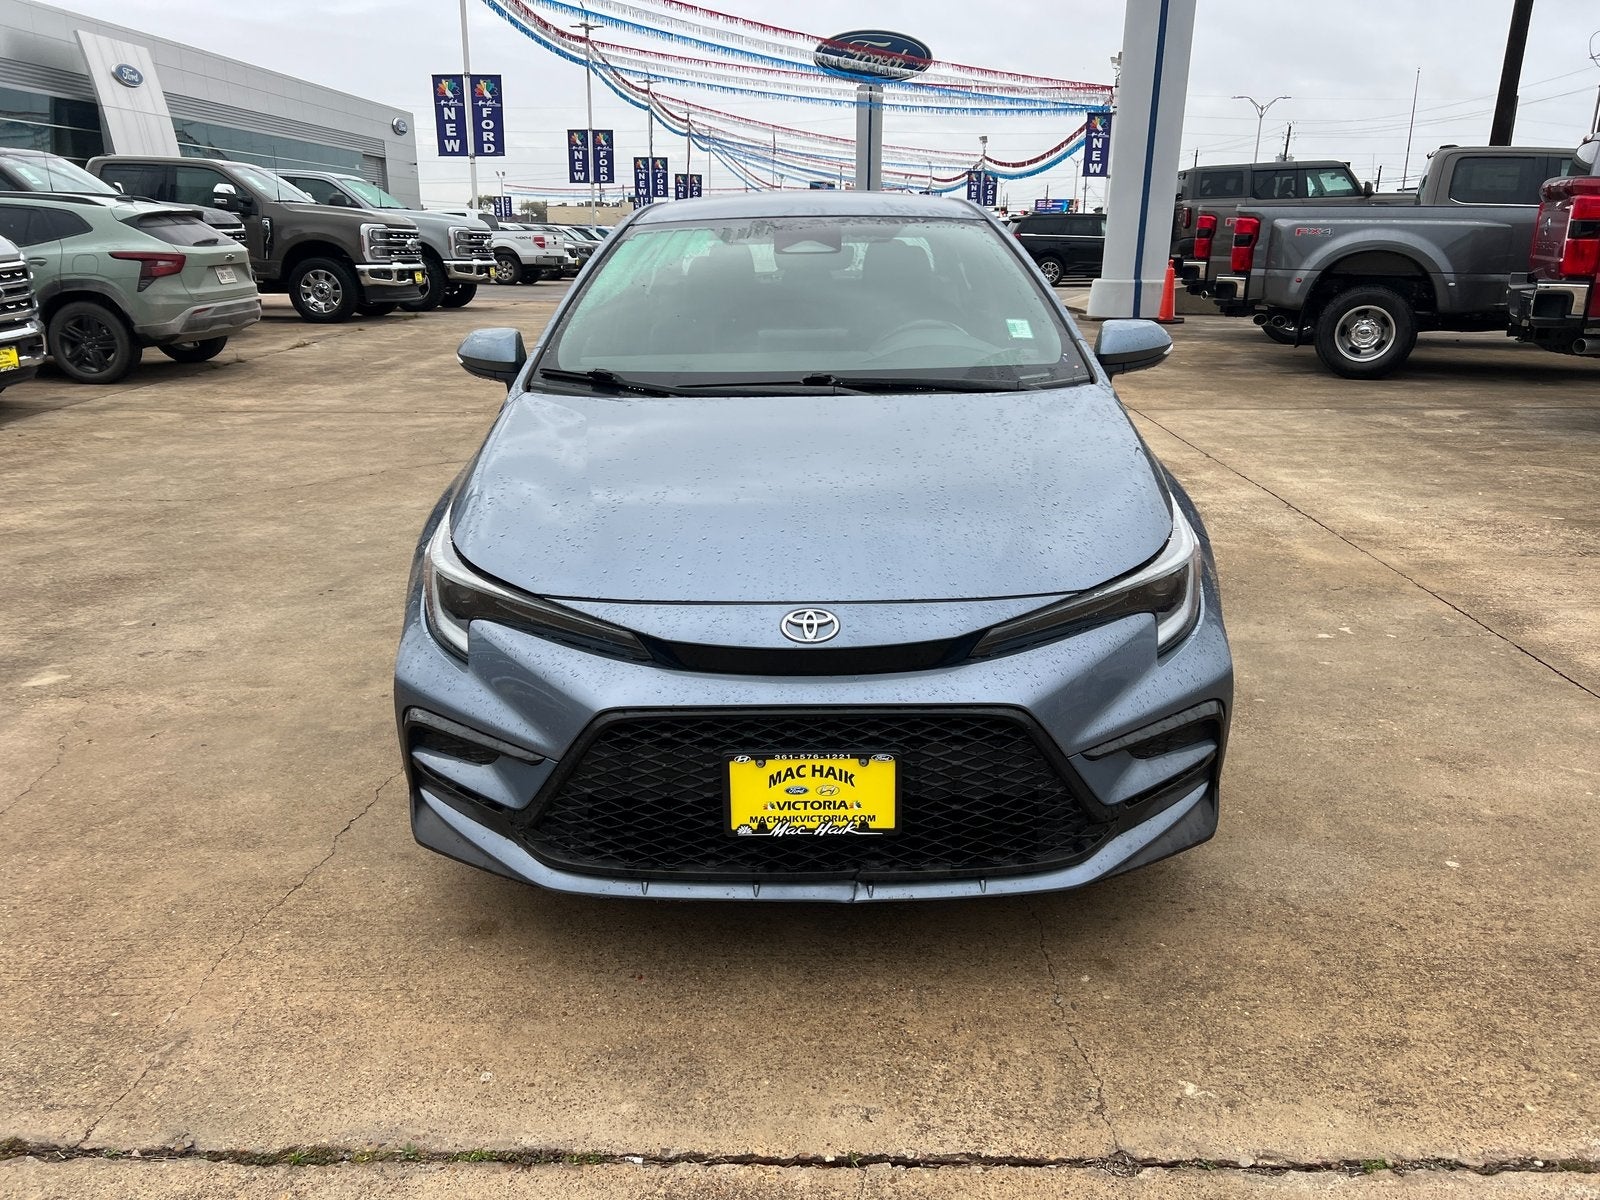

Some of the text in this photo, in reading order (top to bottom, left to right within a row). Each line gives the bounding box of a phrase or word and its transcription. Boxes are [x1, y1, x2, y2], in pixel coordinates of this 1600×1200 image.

[121, 67, 139, 82] Ford
[443, 107, 460, 153] NEW
[481, 107, 496, 153] FORD
[574, 150, 585, 181] NEW
[598, 150, 609, 182] FORD
[1088, 138, 1103, 174] NEW
[638, 173, 647, 196] NEW
[656, 173, 665, 196] FORD
[1295, 227, 1335, 237] FX4
[768, 764, 855, 788] MAC HAIK
[775, 800, 849, 811] VICTORIA
[749, 814, 876, 824] MACHAIKVICTORIA.COM
[769, 821, 861, 837] Mac Haik
